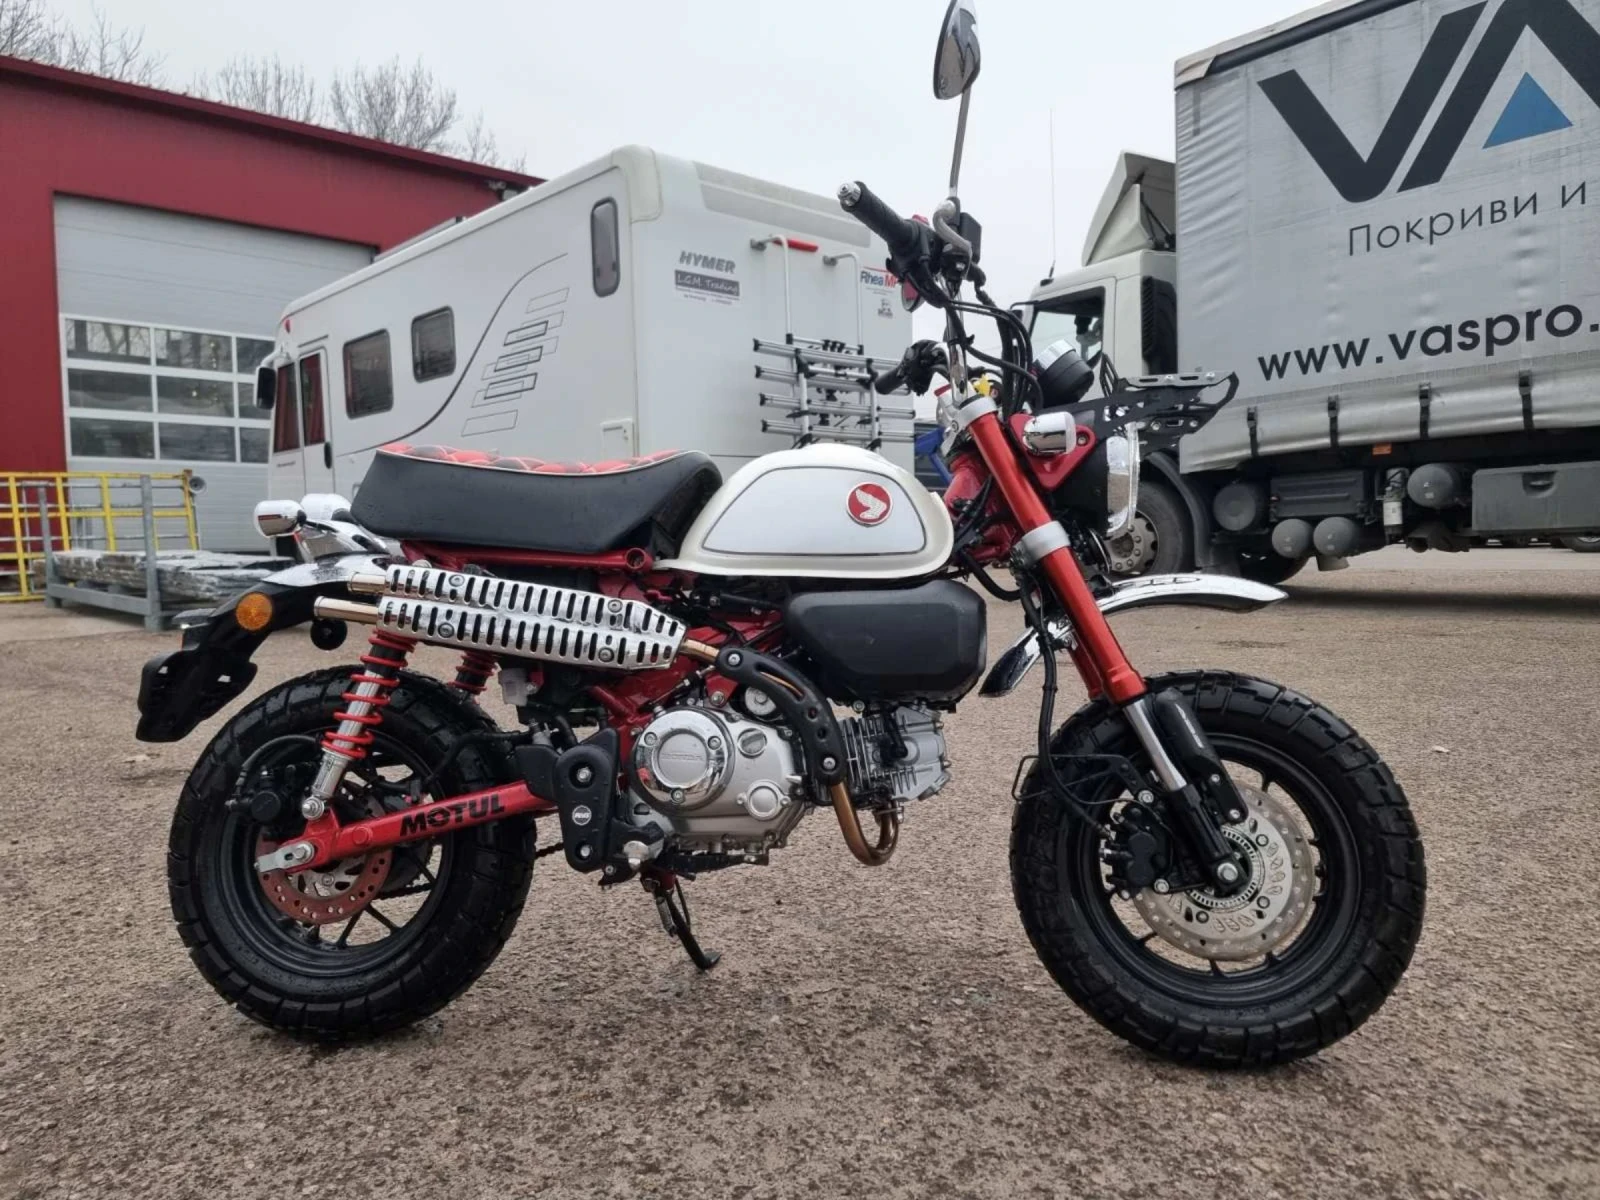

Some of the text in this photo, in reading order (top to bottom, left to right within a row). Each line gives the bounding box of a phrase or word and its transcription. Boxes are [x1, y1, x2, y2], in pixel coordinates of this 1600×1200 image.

[1348, 181, 1587, 257] Покриви и
[679, 250, 736, 274] HYMER
[400, 793, 505, 837] MOTUL
